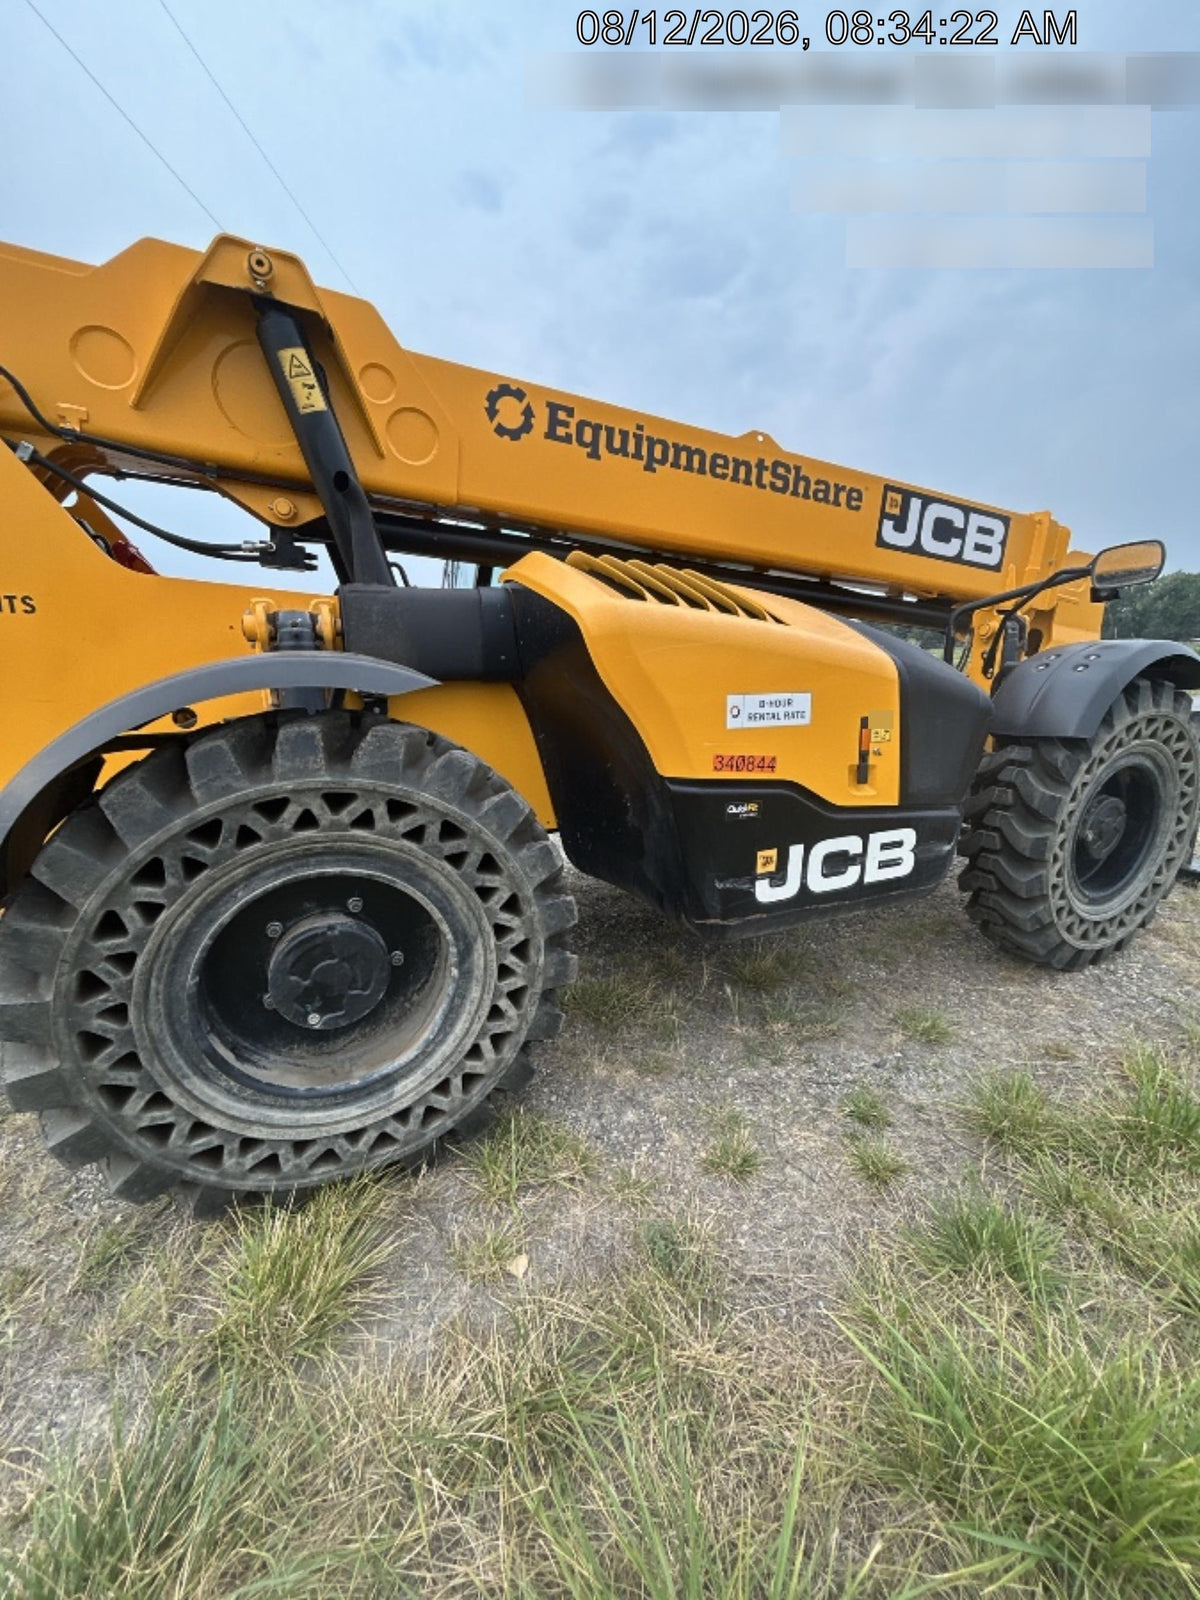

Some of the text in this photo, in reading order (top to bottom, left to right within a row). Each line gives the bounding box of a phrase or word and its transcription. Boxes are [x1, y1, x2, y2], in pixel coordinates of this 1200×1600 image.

[544, 400, 863, 512] EquipmentShare
[881, 497, 1006, 566] JCB
[713, 754, 777, 773] 340844
[755, 828, 917, 903] JCB
